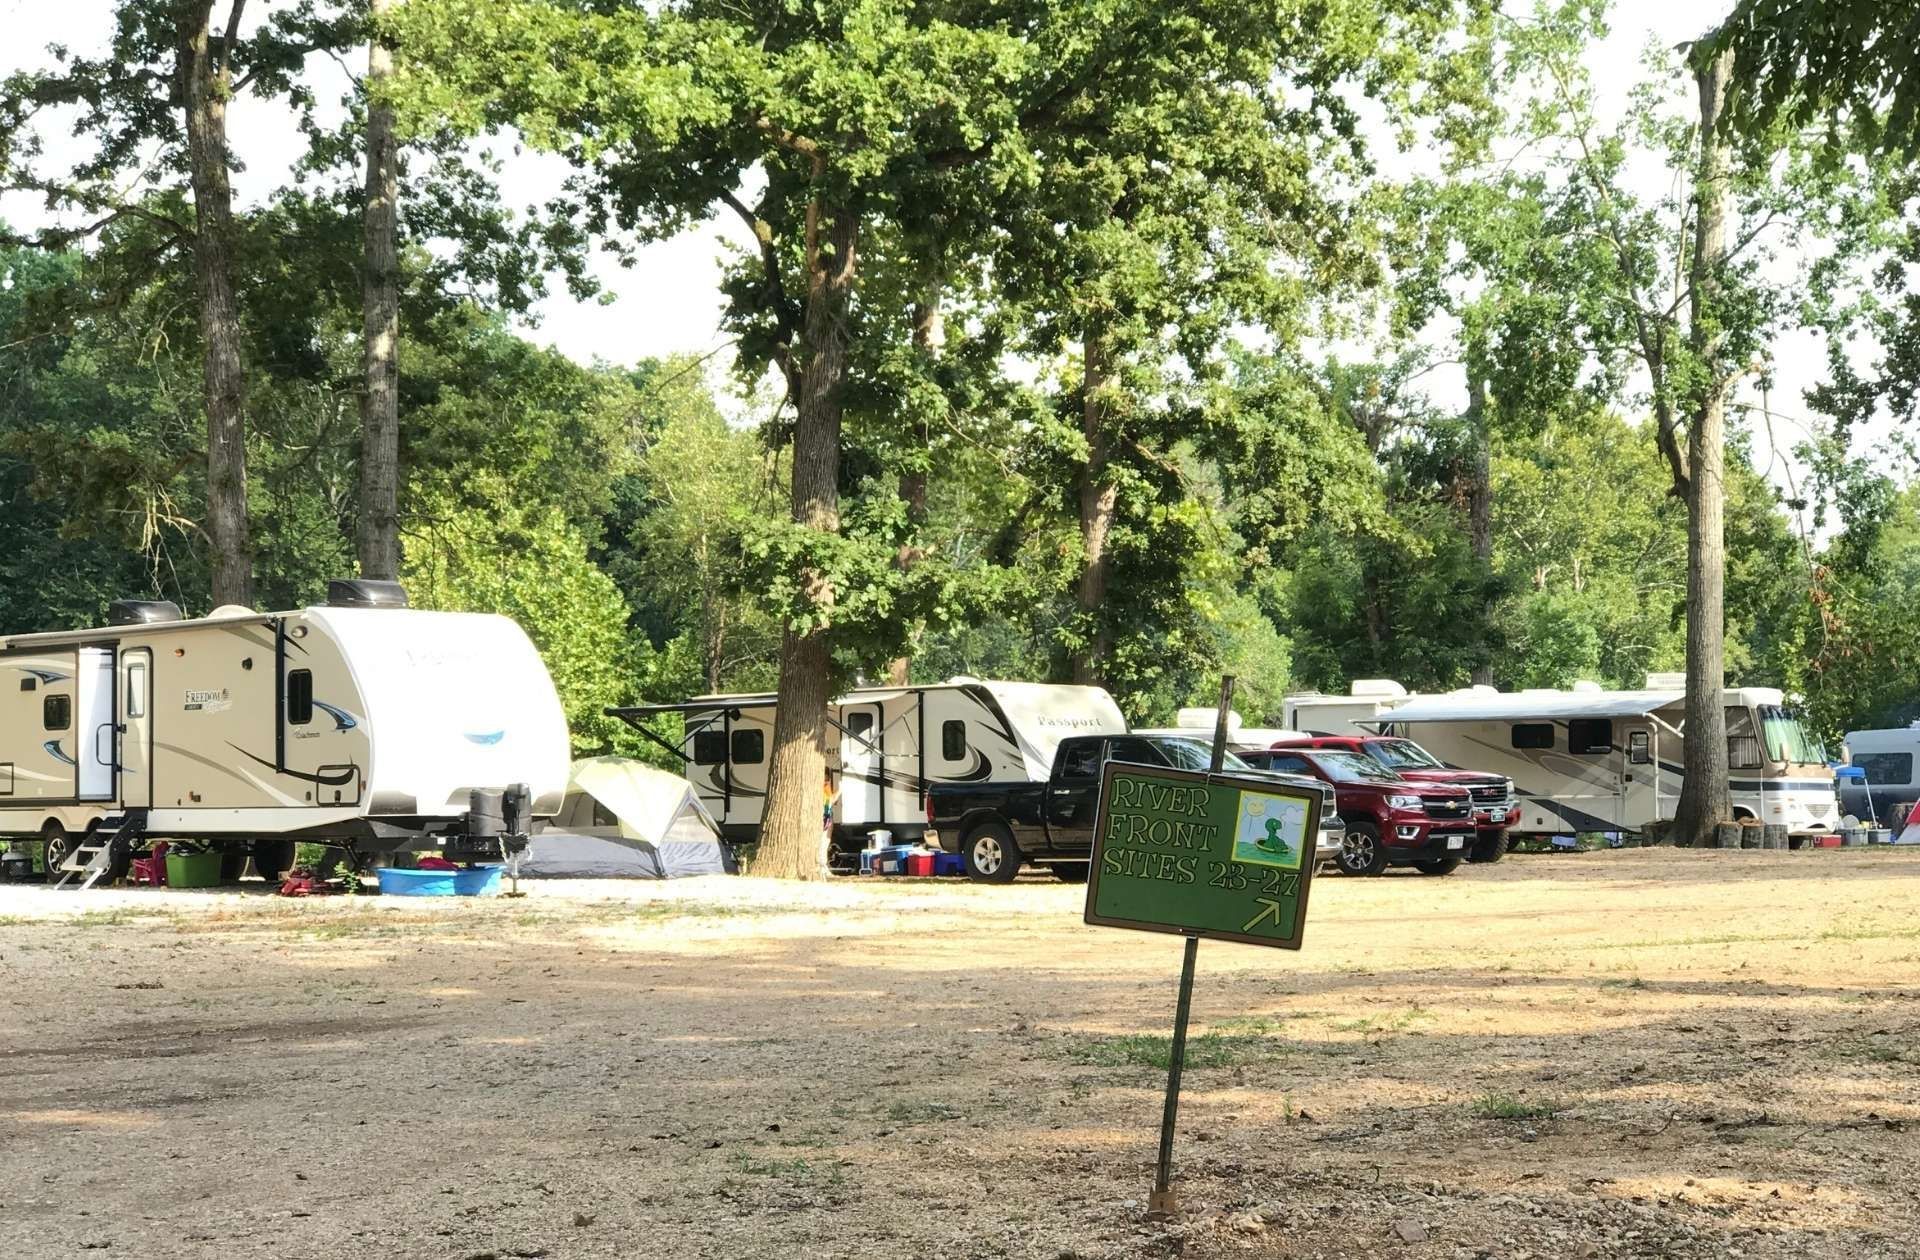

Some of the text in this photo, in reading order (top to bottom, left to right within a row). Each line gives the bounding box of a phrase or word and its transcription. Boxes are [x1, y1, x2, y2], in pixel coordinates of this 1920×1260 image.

[185, 690, 221, 703] FREEDOM
[1038, 715, 1104, 728] Passport
[1112, 778, 1210, 817] RIVER
[1108, 814, 1218, 851] FRONT
[1103, 848, 1300, 897] SITES 23-27
